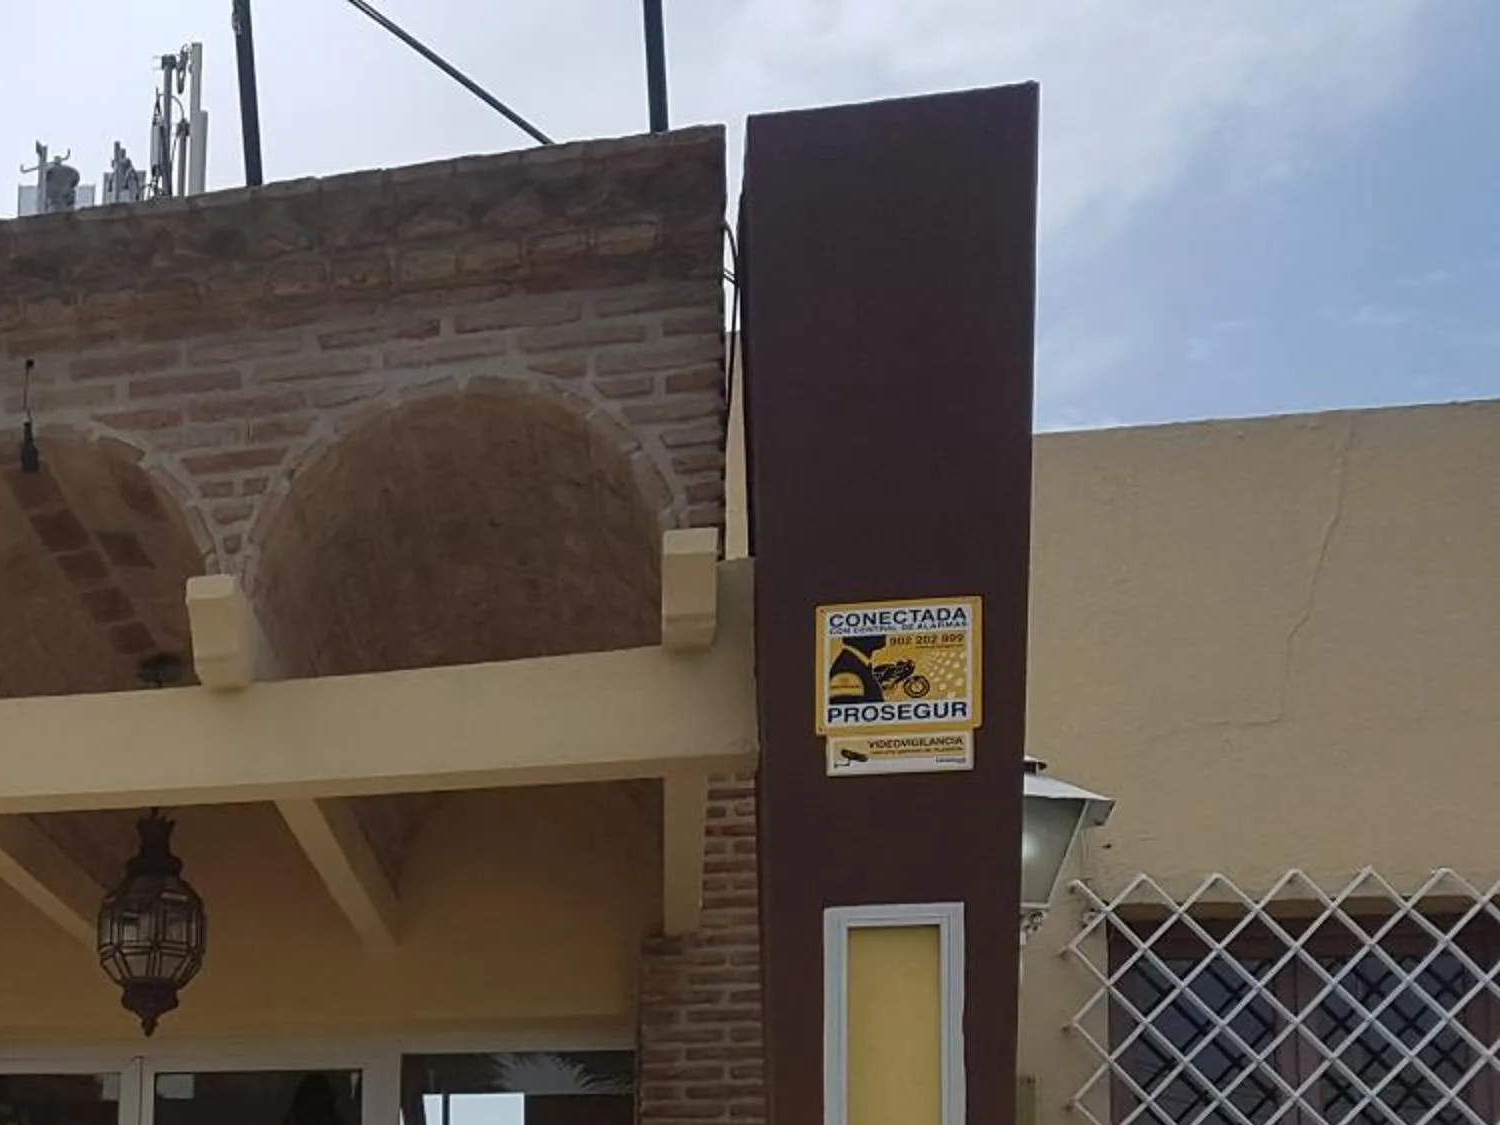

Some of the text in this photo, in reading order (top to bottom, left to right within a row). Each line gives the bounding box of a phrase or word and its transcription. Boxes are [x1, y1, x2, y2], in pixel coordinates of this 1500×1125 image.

[829, 608, 967, 628] CONECTADA
[902, 623, 914, 631] DE
[917, 620, 967, 630] ALARMAS
[827, 702, 967, 723] PROSEGUR
[868, 736, 964, 749] VIDEOVIGILANCIA
